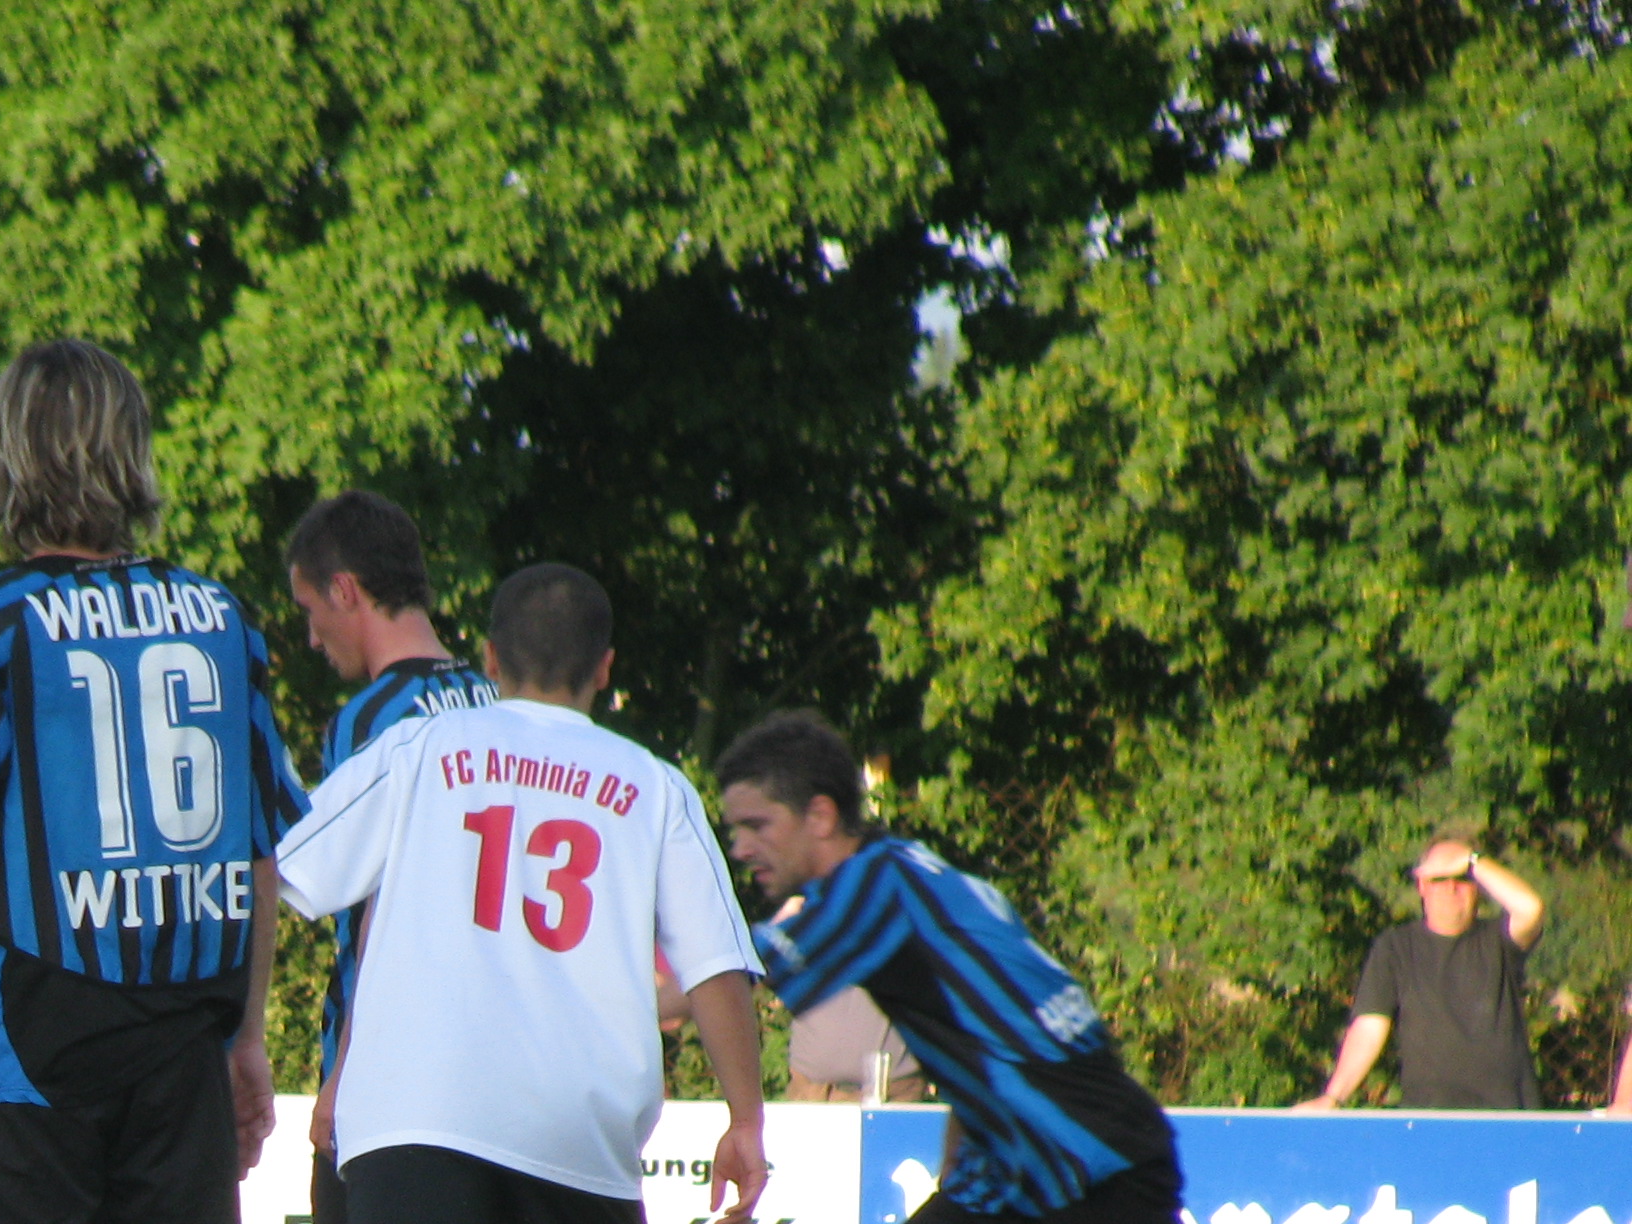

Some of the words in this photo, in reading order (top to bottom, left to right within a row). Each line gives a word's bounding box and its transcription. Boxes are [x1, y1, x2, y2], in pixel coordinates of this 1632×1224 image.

[25, 581, 230, 641] WALDHOF
[66, 642, 223, 860] 16
[440, 749, 475, 790] FC
[485, 748, 591, 800] Arminia
[59, 861, 252, 930] WITTKE
[463, 804, 603, 954] 13
